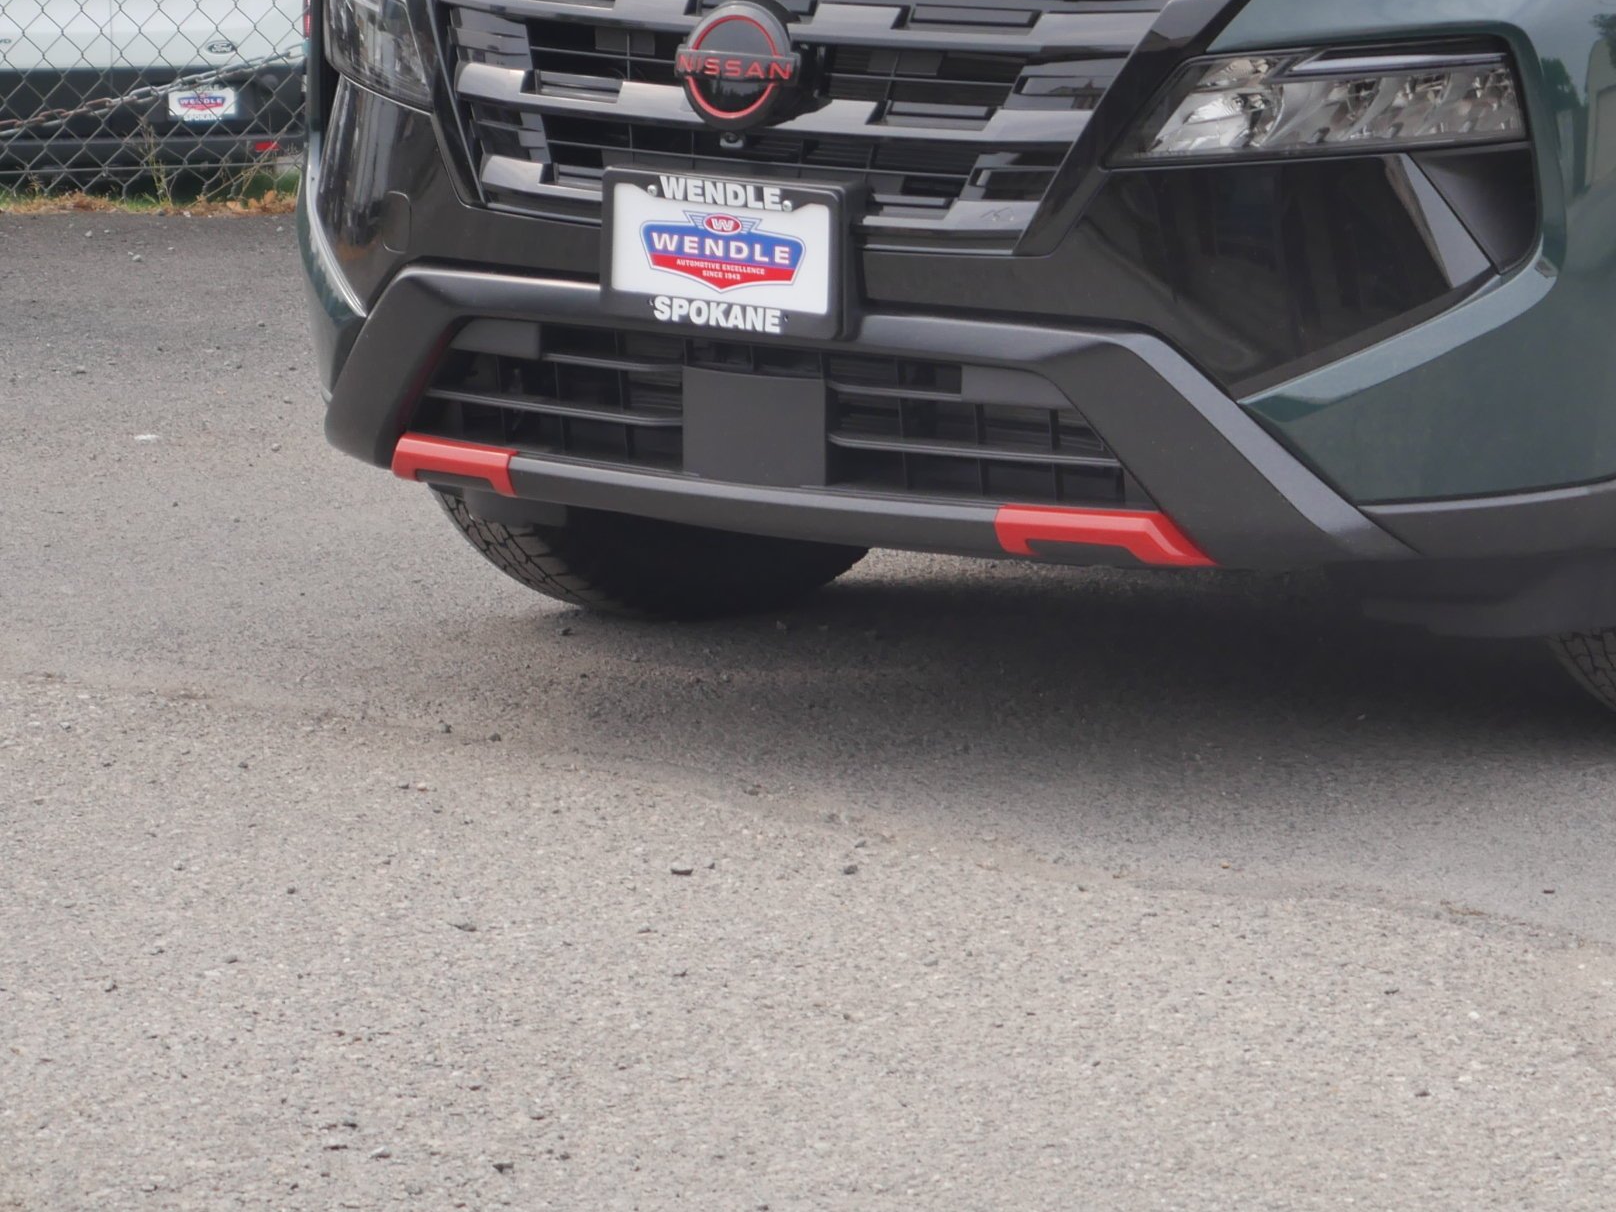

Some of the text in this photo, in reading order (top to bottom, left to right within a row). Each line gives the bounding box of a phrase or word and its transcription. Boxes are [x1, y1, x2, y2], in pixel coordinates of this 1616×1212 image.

[676, 53, 792, 80] NISSAN
[659, 175, 783, 211] WENDLE
[711, 217, 735, 232] W
[651, 232, 790, 265] WENDLE
[676, 258, 766, 276] AUTOMOTIVE EXCELLENCE
[702, 269, 724, 279] SINCE
[652, 295, 781, 334] SPOKANE
